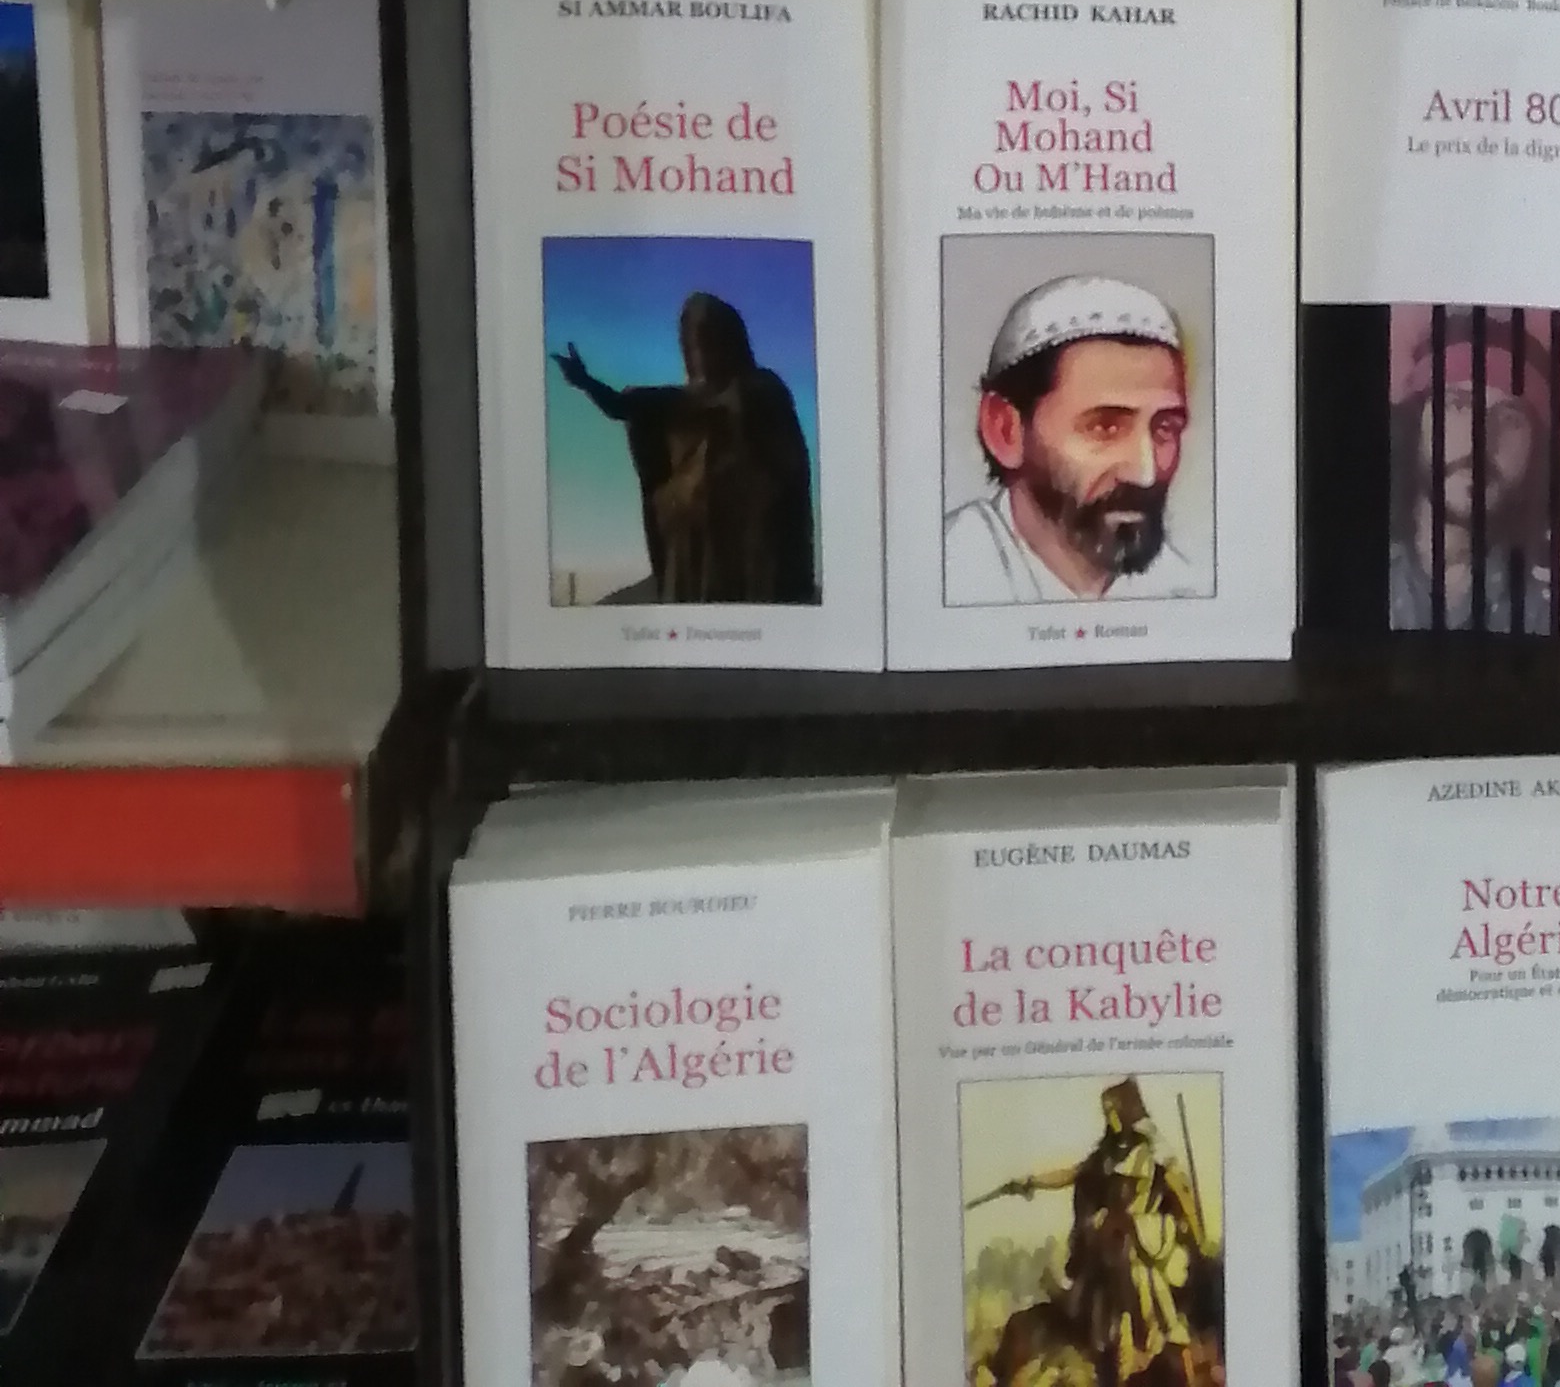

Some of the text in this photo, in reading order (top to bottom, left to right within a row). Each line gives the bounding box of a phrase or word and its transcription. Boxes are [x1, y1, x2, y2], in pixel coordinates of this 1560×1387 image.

[982, 3, 1175, 25] RACHID KAHAR
[1006, 78, 1138, 116] Moi, Si
[1423, 88, 1511, 122] Avril
[573, 100, 777, 141] Poésie de
[995, 118, 1153, 153] Mohand
[1407, 136, 1430, 153] Le
[1434, 139, 1471, 158] prix
[1476, 135, 1499, 154] de
[1503, 136, 1519, 155] la
[557, 153, 794, 195] Si Mohand
[973, 161, 1177, 193] Ou M'Hand
[975, 841, 1191, 867] EUGÈNE DAUMAS
[962, 929, 1217, 975] La conquête
[545, 984, 781, 1034] Sociologie
[953, 982, 1222, 1027] de la Kabylie
[534, 1037, 794, 1089] de l'Algérie
